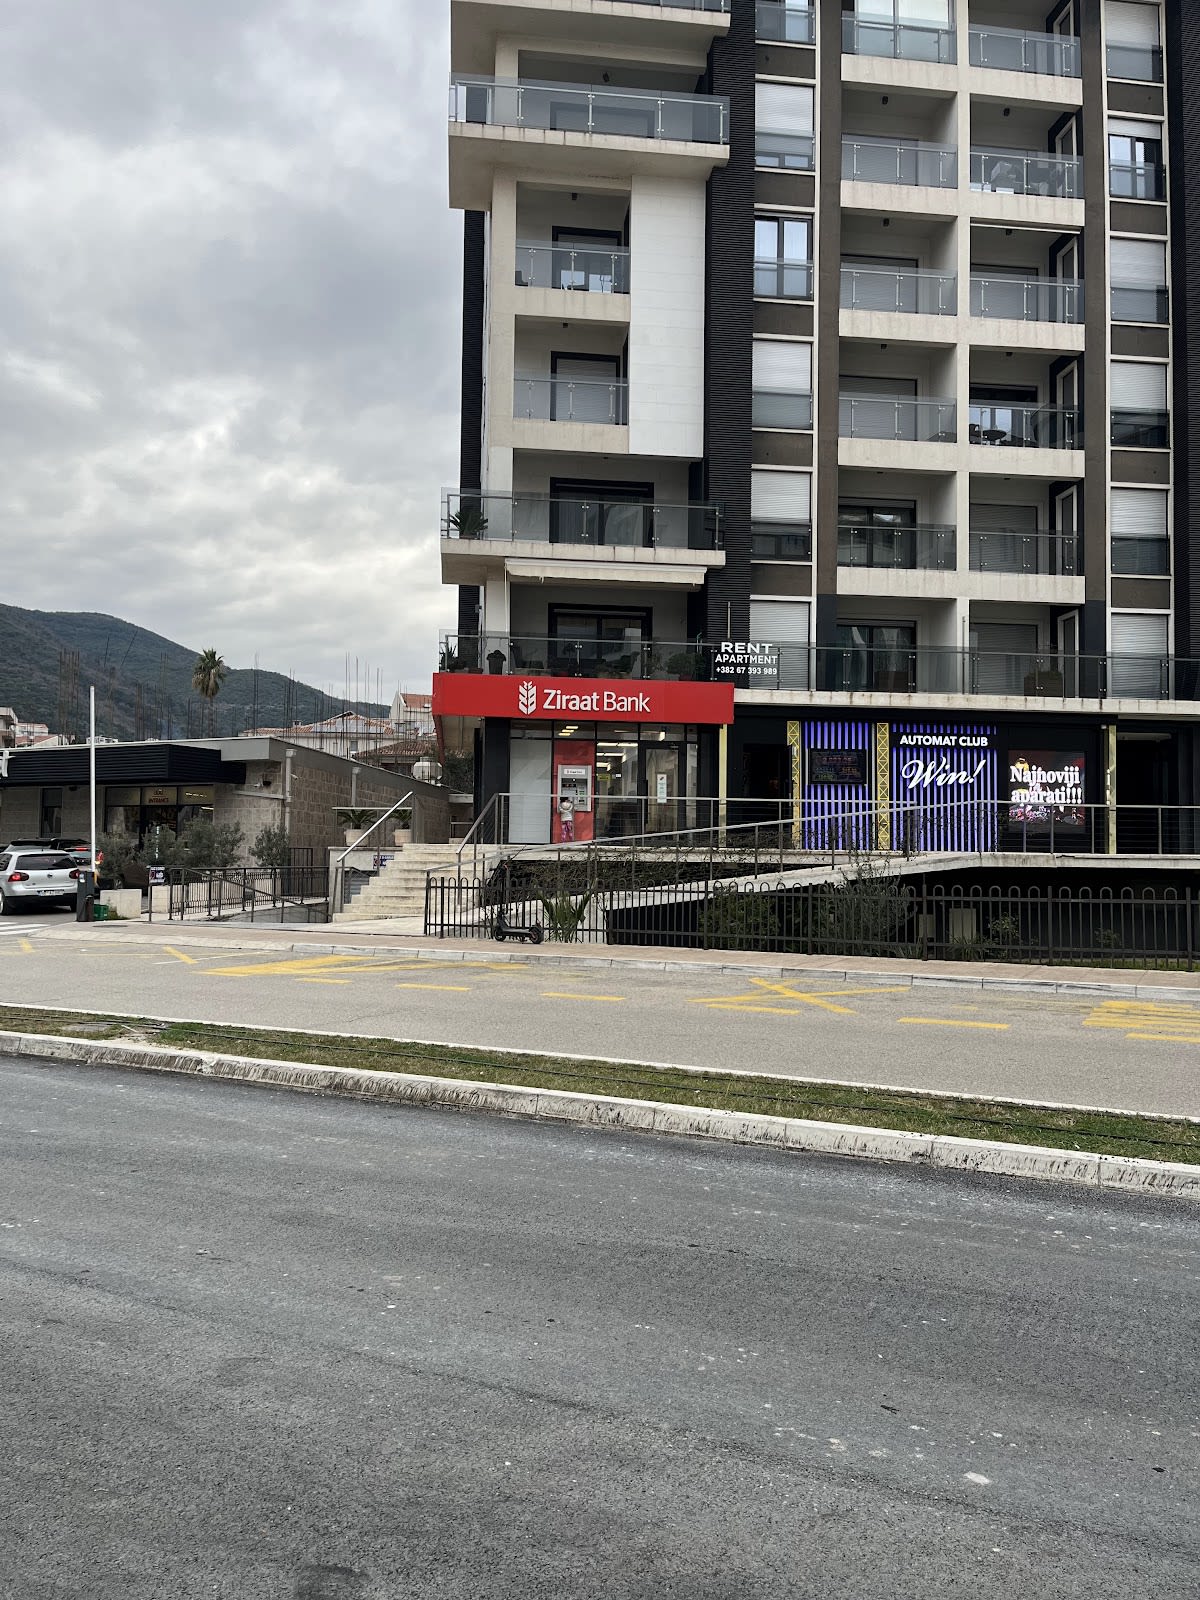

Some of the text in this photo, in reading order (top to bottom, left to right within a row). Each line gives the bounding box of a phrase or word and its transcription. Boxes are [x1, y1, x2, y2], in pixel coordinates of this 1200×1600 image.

[721, 641, 773, 654] RENT
[715, 654, 778, 664] APARTMENT
[716, 666, 777, 675] +382 67 393 989
[542, 689, 651, 712] Ziraat Bank
[900, 735, 988, 747] AUTOMAT CLUB
[901, 756, 986, 789] Win!
[1010, 765, 1080, 787] Najnoviji
